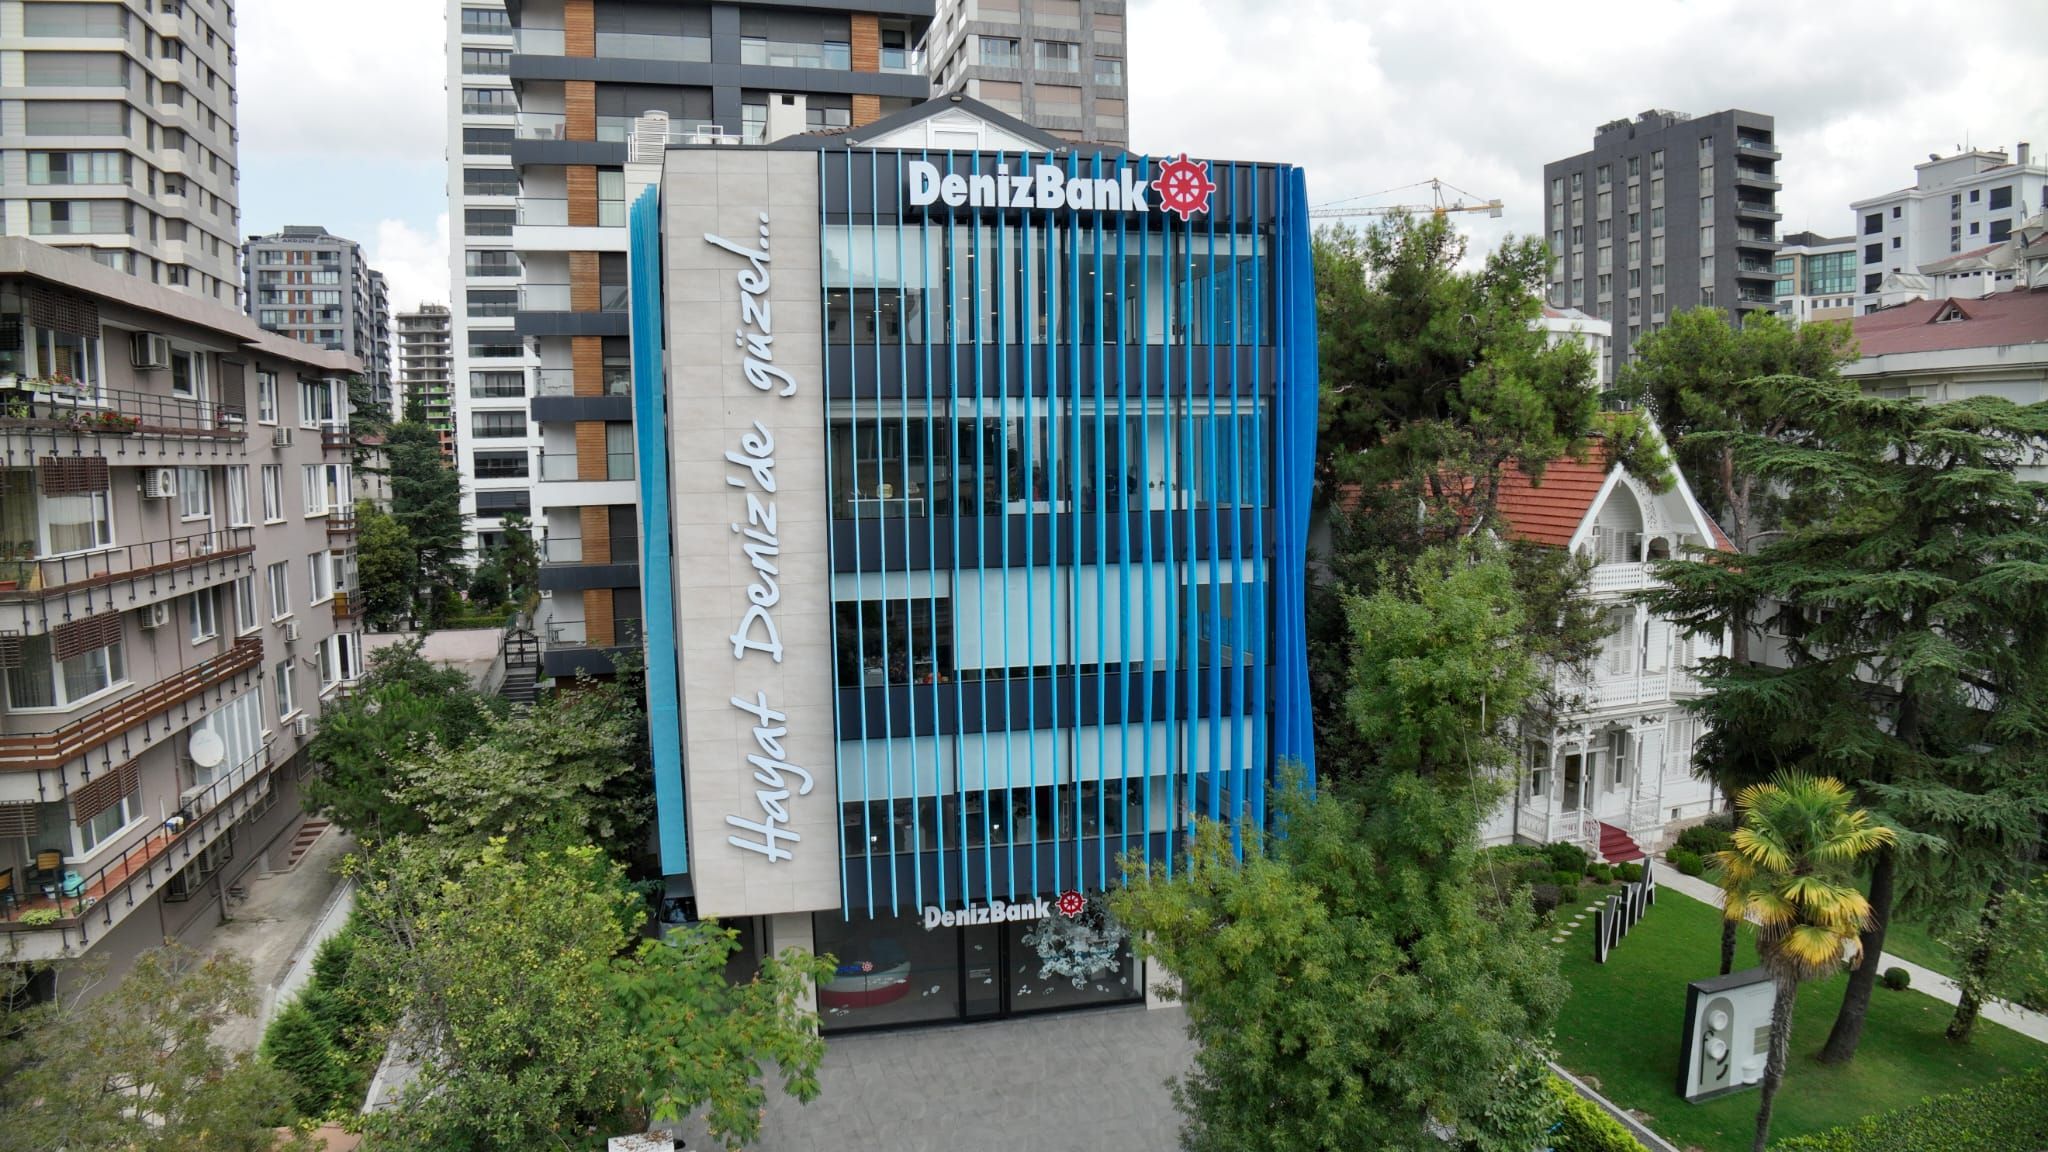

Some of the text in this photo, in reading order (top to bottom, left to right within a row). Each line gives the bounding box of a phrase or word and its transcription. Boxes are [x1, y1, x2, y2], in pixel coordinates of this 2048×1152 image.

[909, 160, 1150, 212] DenizBank
[703, 211, 814, 864] Hayat Deniz'de güzel...
[924, 897, 1051, 929] DenizBank
